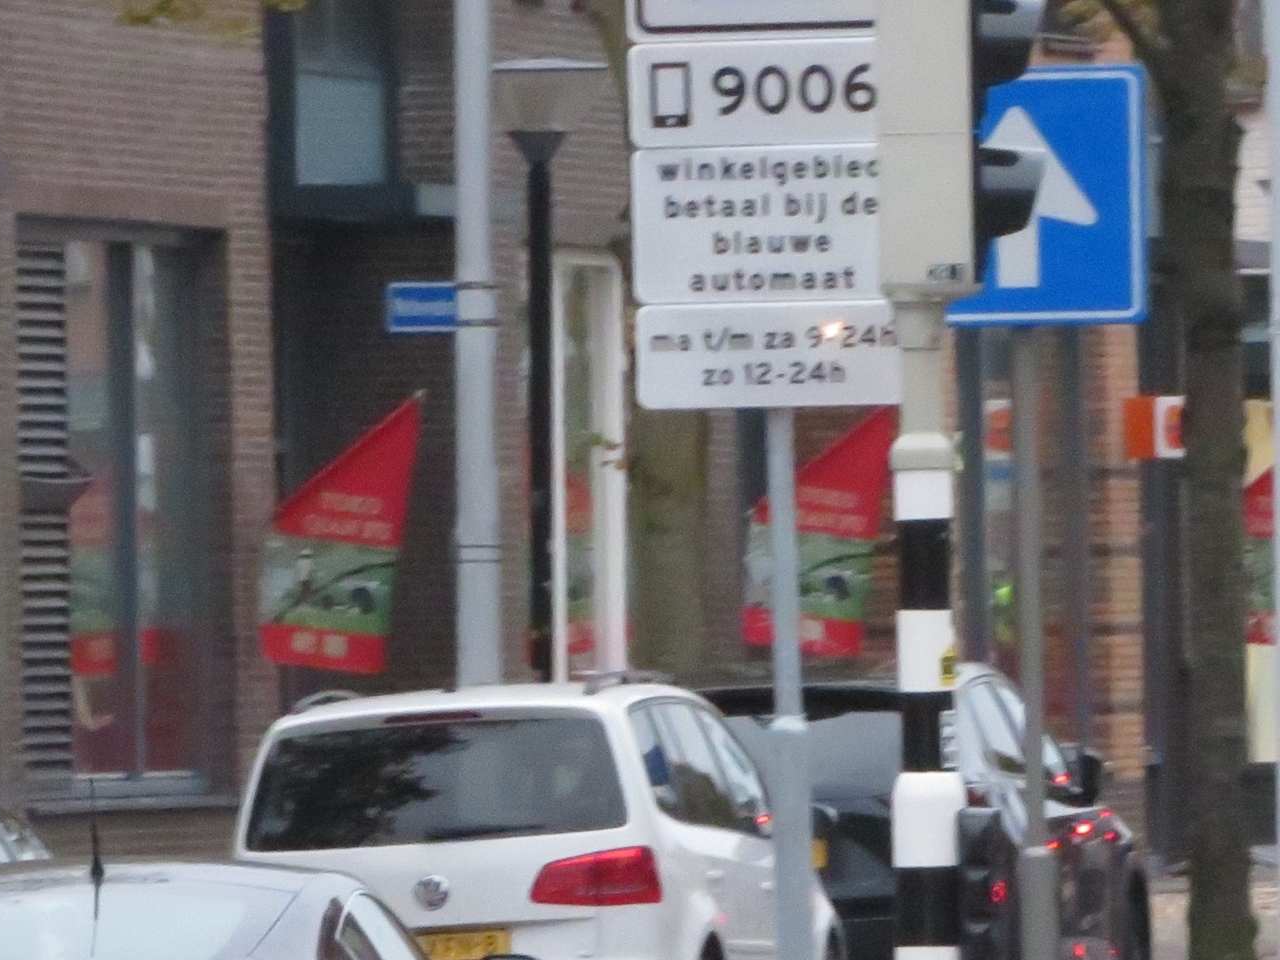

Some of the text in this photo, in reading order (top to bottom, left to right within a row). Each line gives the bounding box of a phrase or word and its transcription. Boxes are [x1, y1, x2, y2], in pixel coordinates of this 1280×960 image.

[712, 63, 877, 116] 9006
[665, 191, 878, 223] betaal bij de
[712, 231, 831, 254] blauwe
[689, 266, 855, 292] automaat
[650, 325, 898, 351] ma t/m za 924h
[702, 361, 847, 386] zo 12-24h
